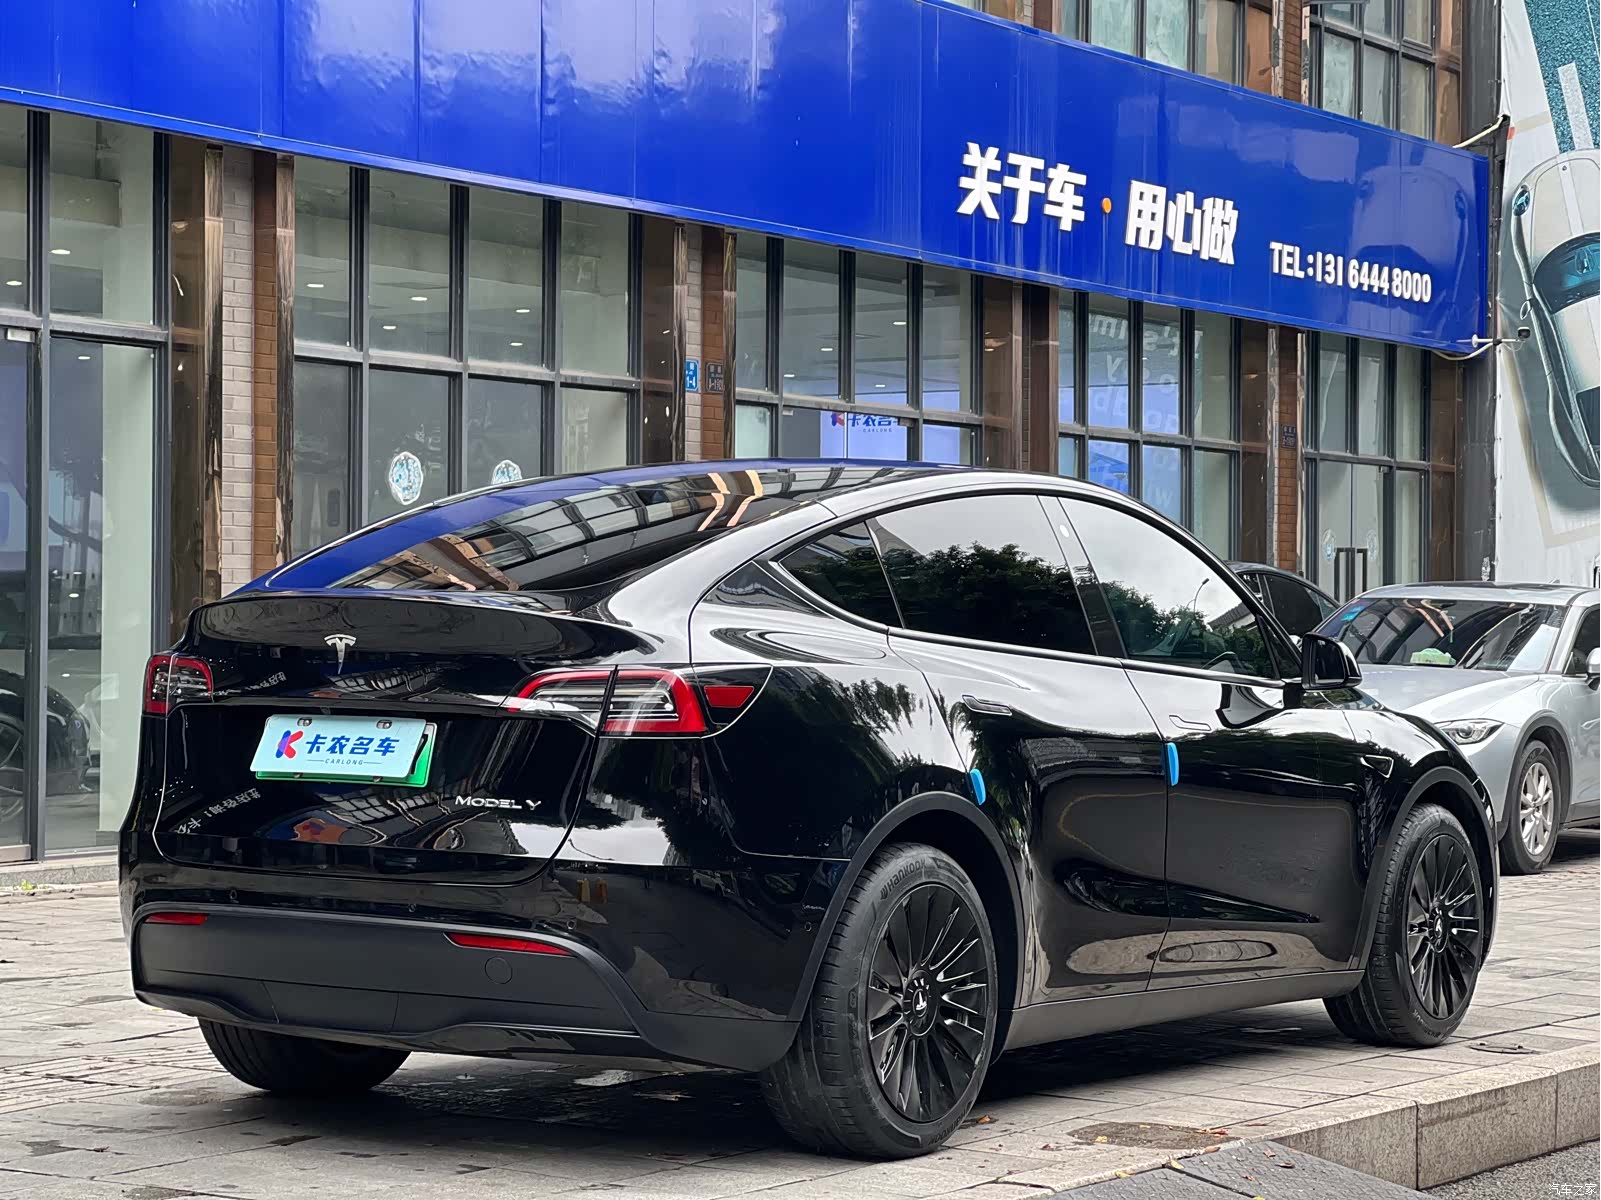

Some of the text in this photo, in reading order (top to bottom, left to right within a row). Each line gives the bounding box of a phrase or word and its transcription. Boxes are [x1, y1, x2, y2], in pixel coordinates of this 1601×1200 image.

[305, 734, 400, 757] 卡农名车
[325, 758, 364, 766] CARLONG
[455, 795, 542, 811] MODEL Y
